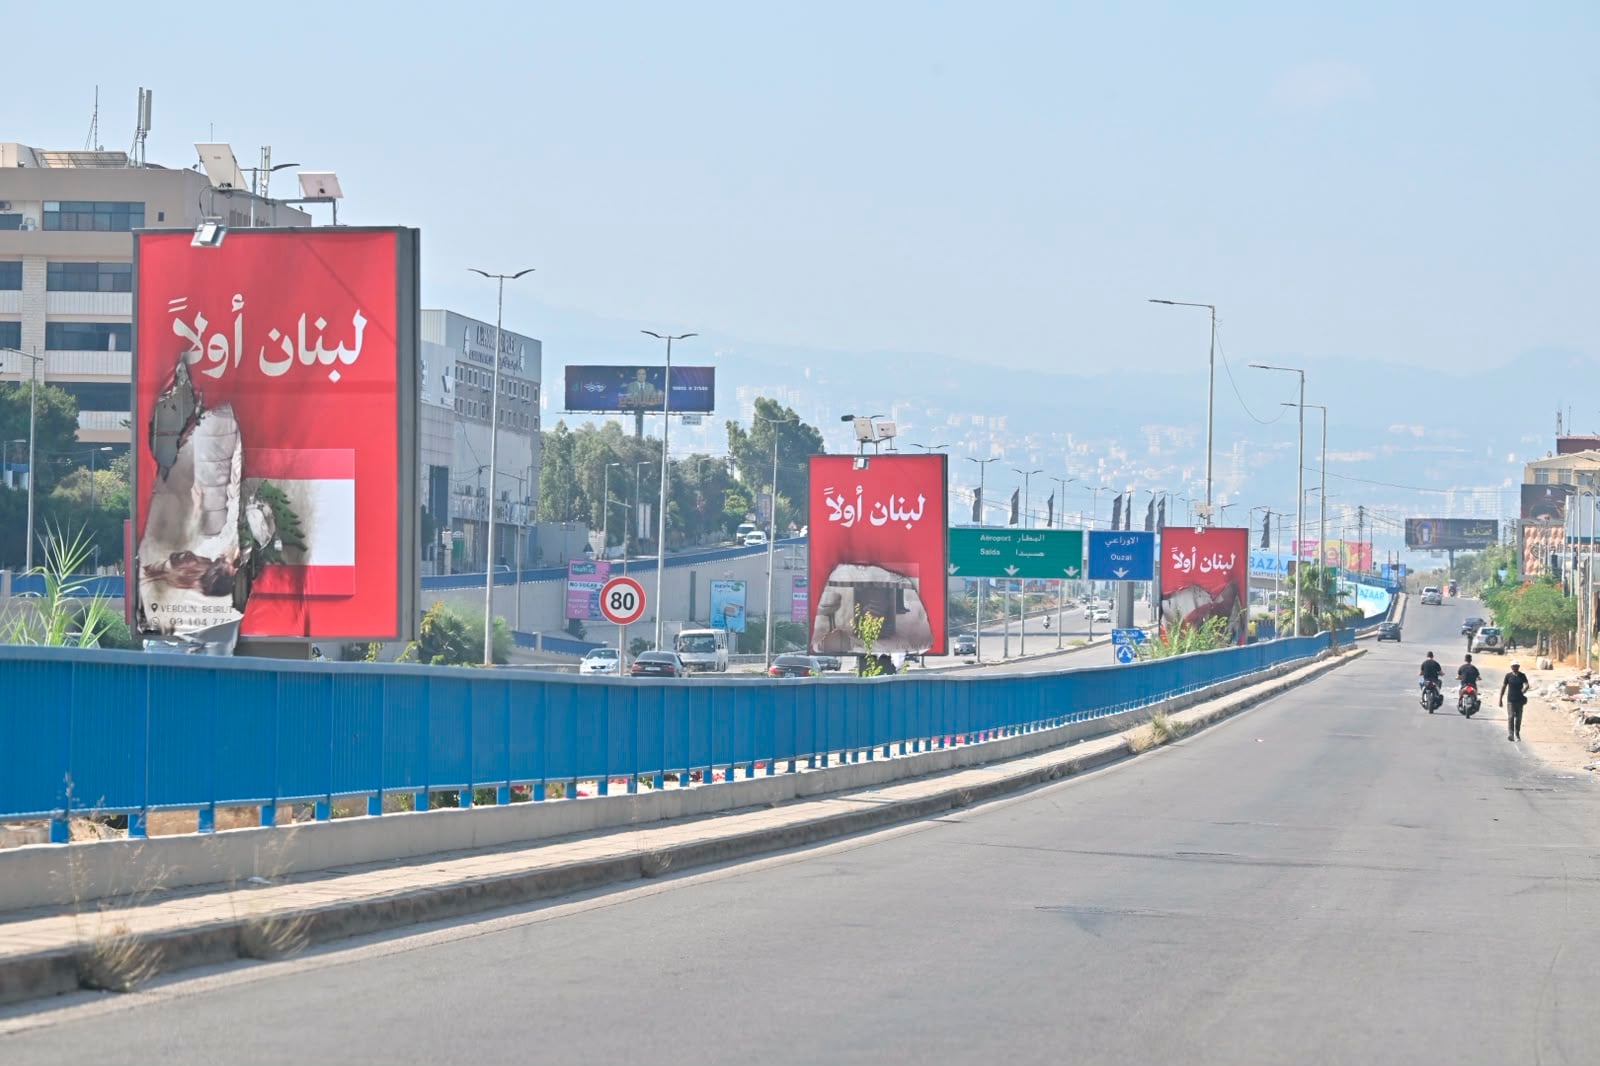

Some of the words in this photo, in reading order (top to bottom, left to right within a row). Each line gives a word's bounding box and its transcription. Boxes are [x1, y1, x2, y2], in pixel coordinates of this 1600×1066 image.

[259, 309, 368, 383] لبنان
[823, 484, 863, 528] أولاً
[869, 493, 926, 530] لبنان
[1016, 532, 1045, 544] المطار
[1171, 546, 1197, 573] أولاً
[1200, 552, 1236, 575] لبنان
[1249, 556, 1288, 571] BAZA
[610, 592, 635, 610] 80
[1359, 589, 1385, 601] AZAAR
